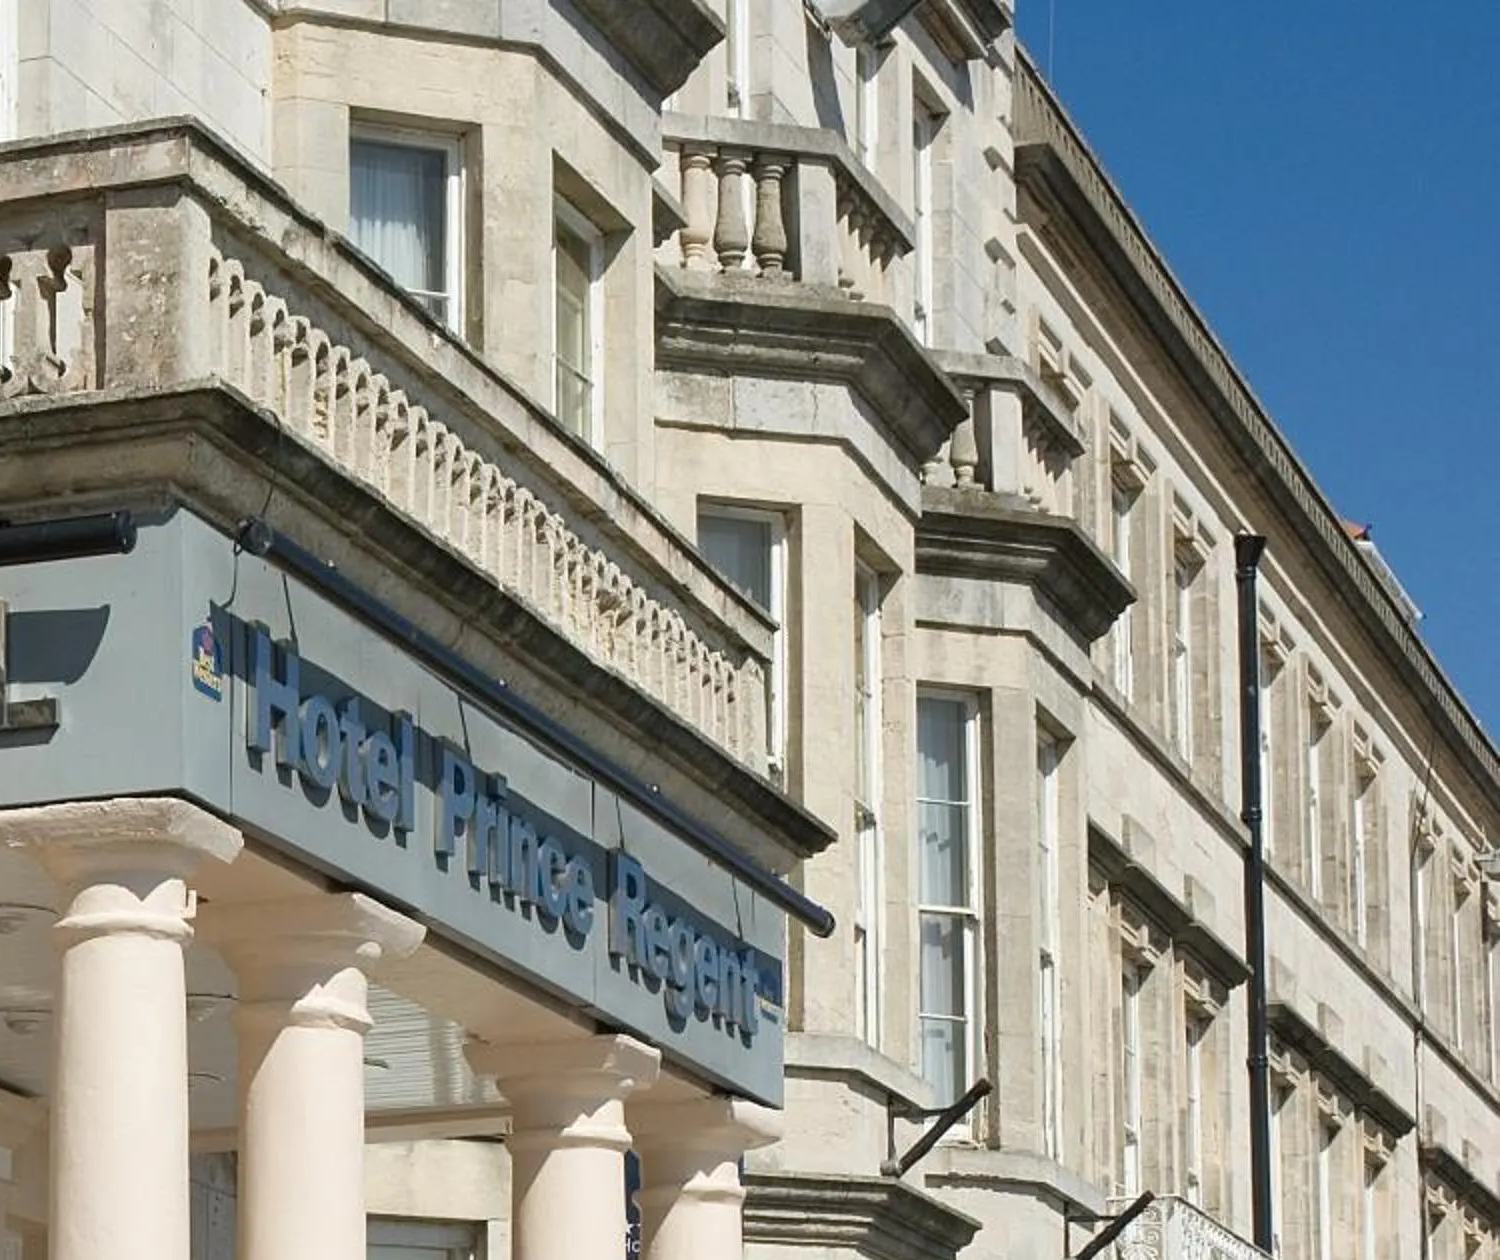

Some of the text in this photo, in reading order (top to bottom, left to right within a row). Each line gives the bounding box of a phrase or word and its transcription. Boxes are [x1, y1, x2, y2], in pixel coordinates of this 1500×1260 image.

[246, 625, 760, 1037] Hotel Prince Regent
